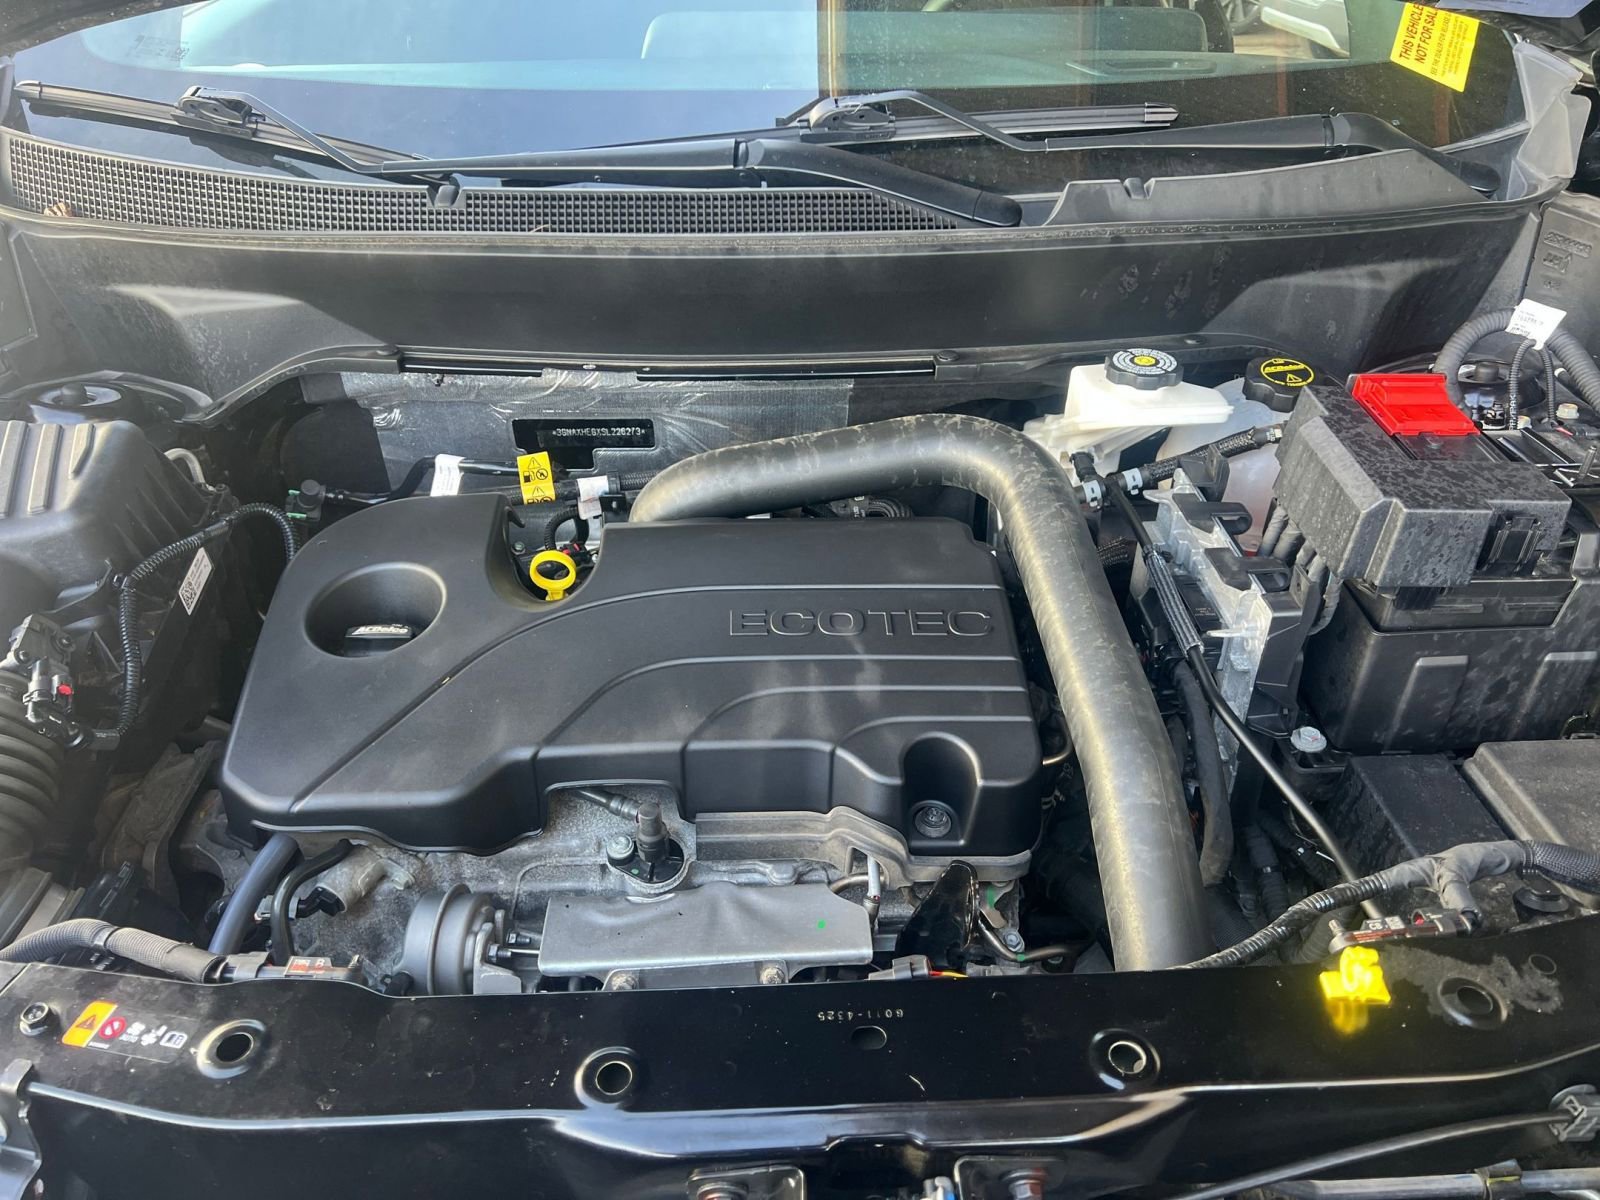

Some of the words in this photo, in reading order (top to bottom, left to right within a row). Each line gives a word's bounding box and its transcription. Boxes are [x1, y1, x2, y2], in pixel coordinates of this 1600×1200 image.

[1405, 3, 1424, 39] VEHICLE
[1420, 26, 1433, 45] FOR
[1399, 40, 1414, 60] THIS
[1415, 43, 1428, 64] NOT
[729, 608, 993, 637] ECOTEC
